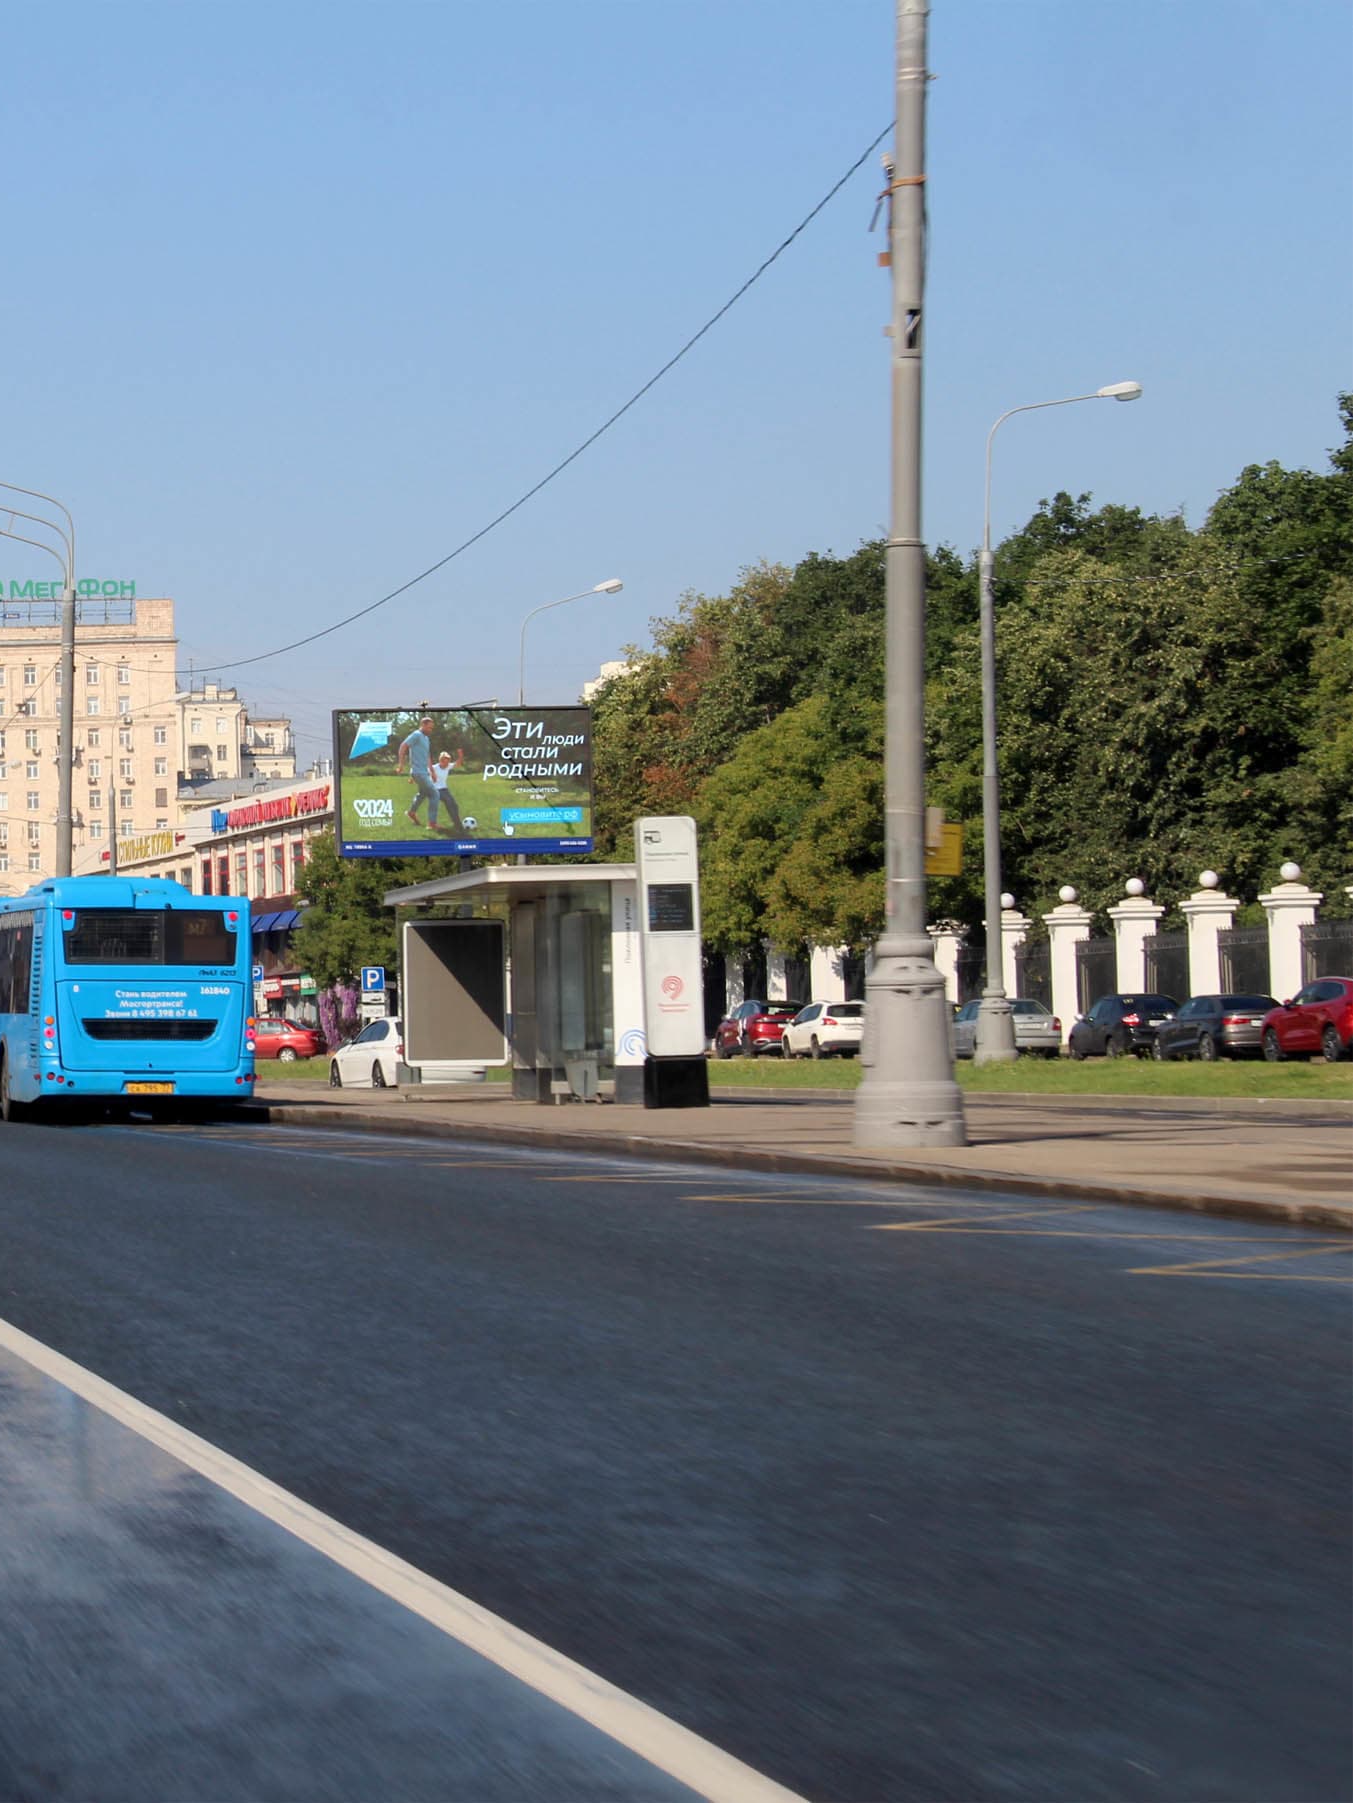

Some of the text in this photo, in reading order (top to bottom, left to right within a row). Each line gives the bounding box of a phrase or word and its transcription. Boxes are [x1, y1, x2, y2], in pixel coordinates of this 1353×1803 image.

[10, 579, 136, 598] МЕГФОН
[491, 717, 585, 747] Эти люди
[501, 746, 559, 760] стали
[482, 763, 583, 781] родными
[353, 799, 394, 818] 2024
[367, 970, 380, 988] P
[115, 990, 139, 998] Стань
